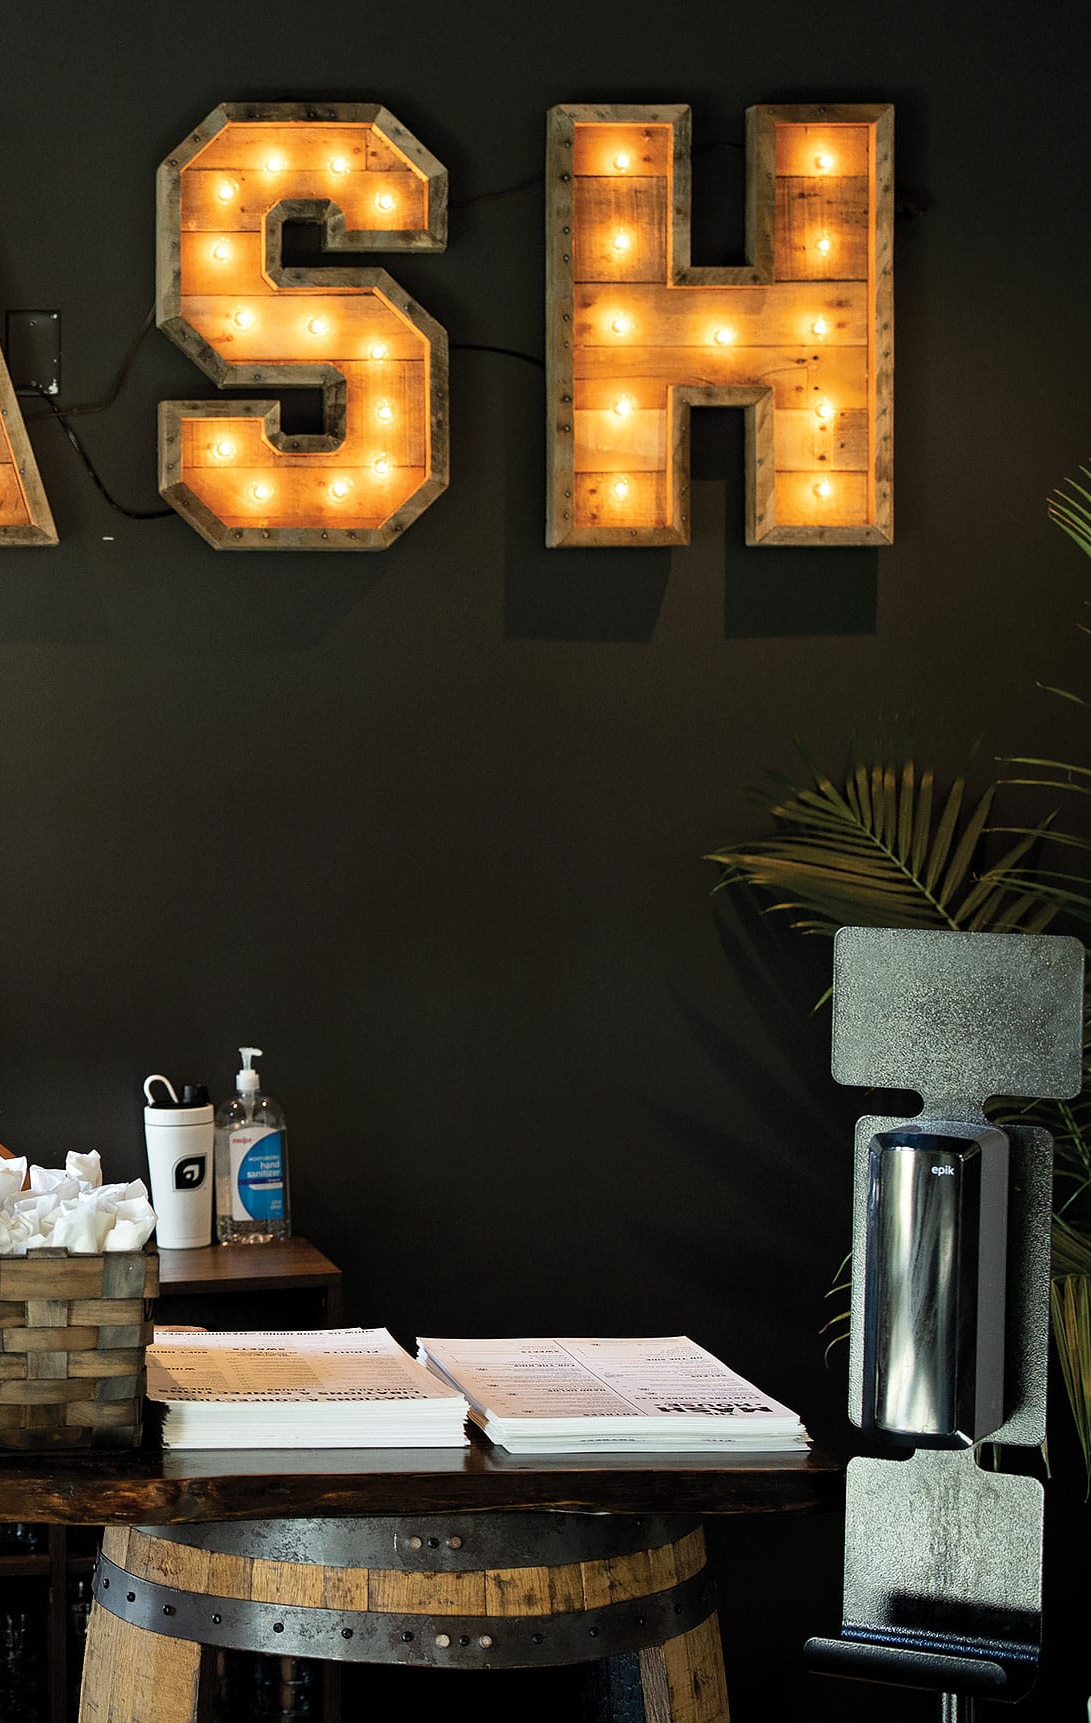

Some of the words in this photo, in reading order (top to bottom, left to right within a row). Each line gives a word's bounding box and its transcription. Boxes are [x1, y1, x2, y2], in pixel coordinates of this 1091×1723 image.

[260, 1161, 280, 1169] hand
[247, 1169, 281, 1178] sanitizer
[931, 1165, 955, 1177] epik
